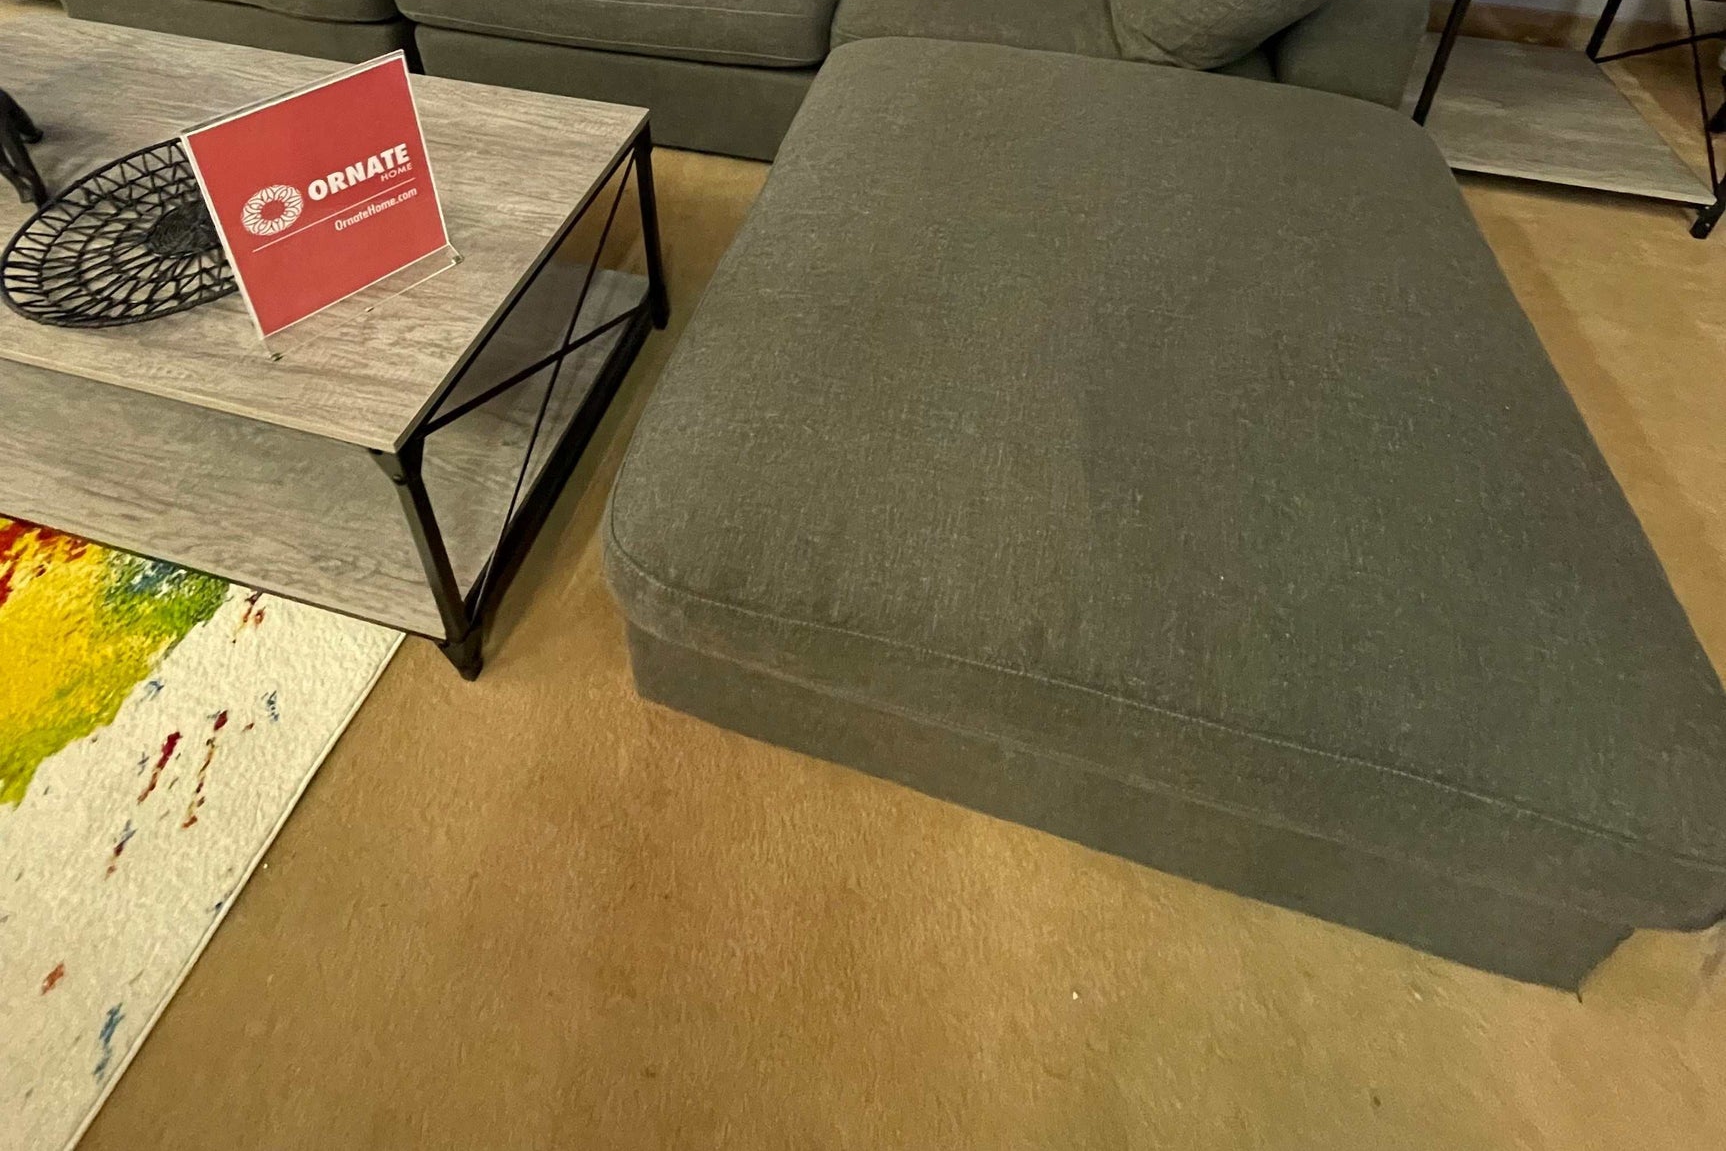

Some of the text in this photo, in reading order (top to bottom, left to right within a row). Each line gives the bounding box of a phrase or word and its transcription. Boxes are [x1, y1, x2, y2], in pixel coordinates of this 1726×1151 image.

[308, 143, 410, 201] ORNATE
[380, 162, 413, 182] HOME
[334, 187, 418, 231] OrnateHome.com
